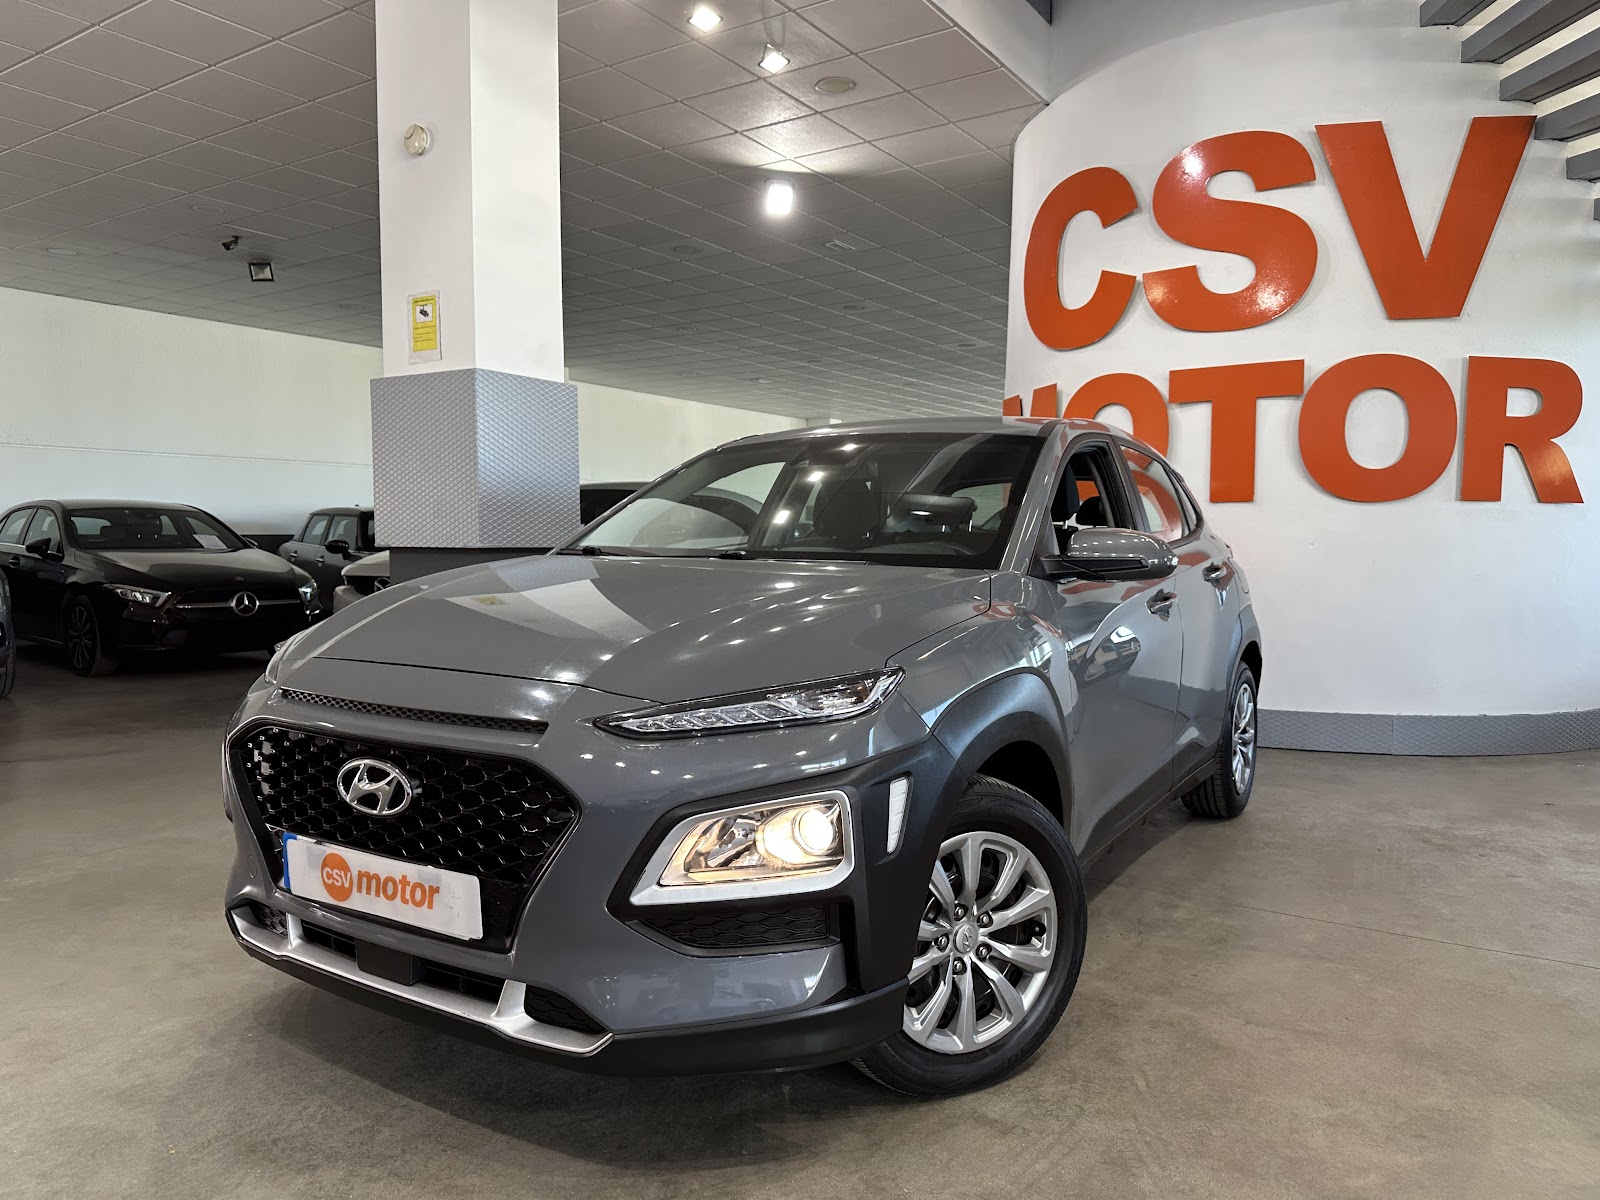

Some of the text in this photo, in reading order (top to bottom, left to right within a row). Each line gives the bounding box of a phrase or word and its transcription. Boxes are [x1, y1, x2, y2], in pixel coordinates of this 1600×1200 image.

[1023, 115, 1537, 351] CSV
[1002, 353, 1584, 504] OTOR
[322, 866, 440, 910] CSV motor
